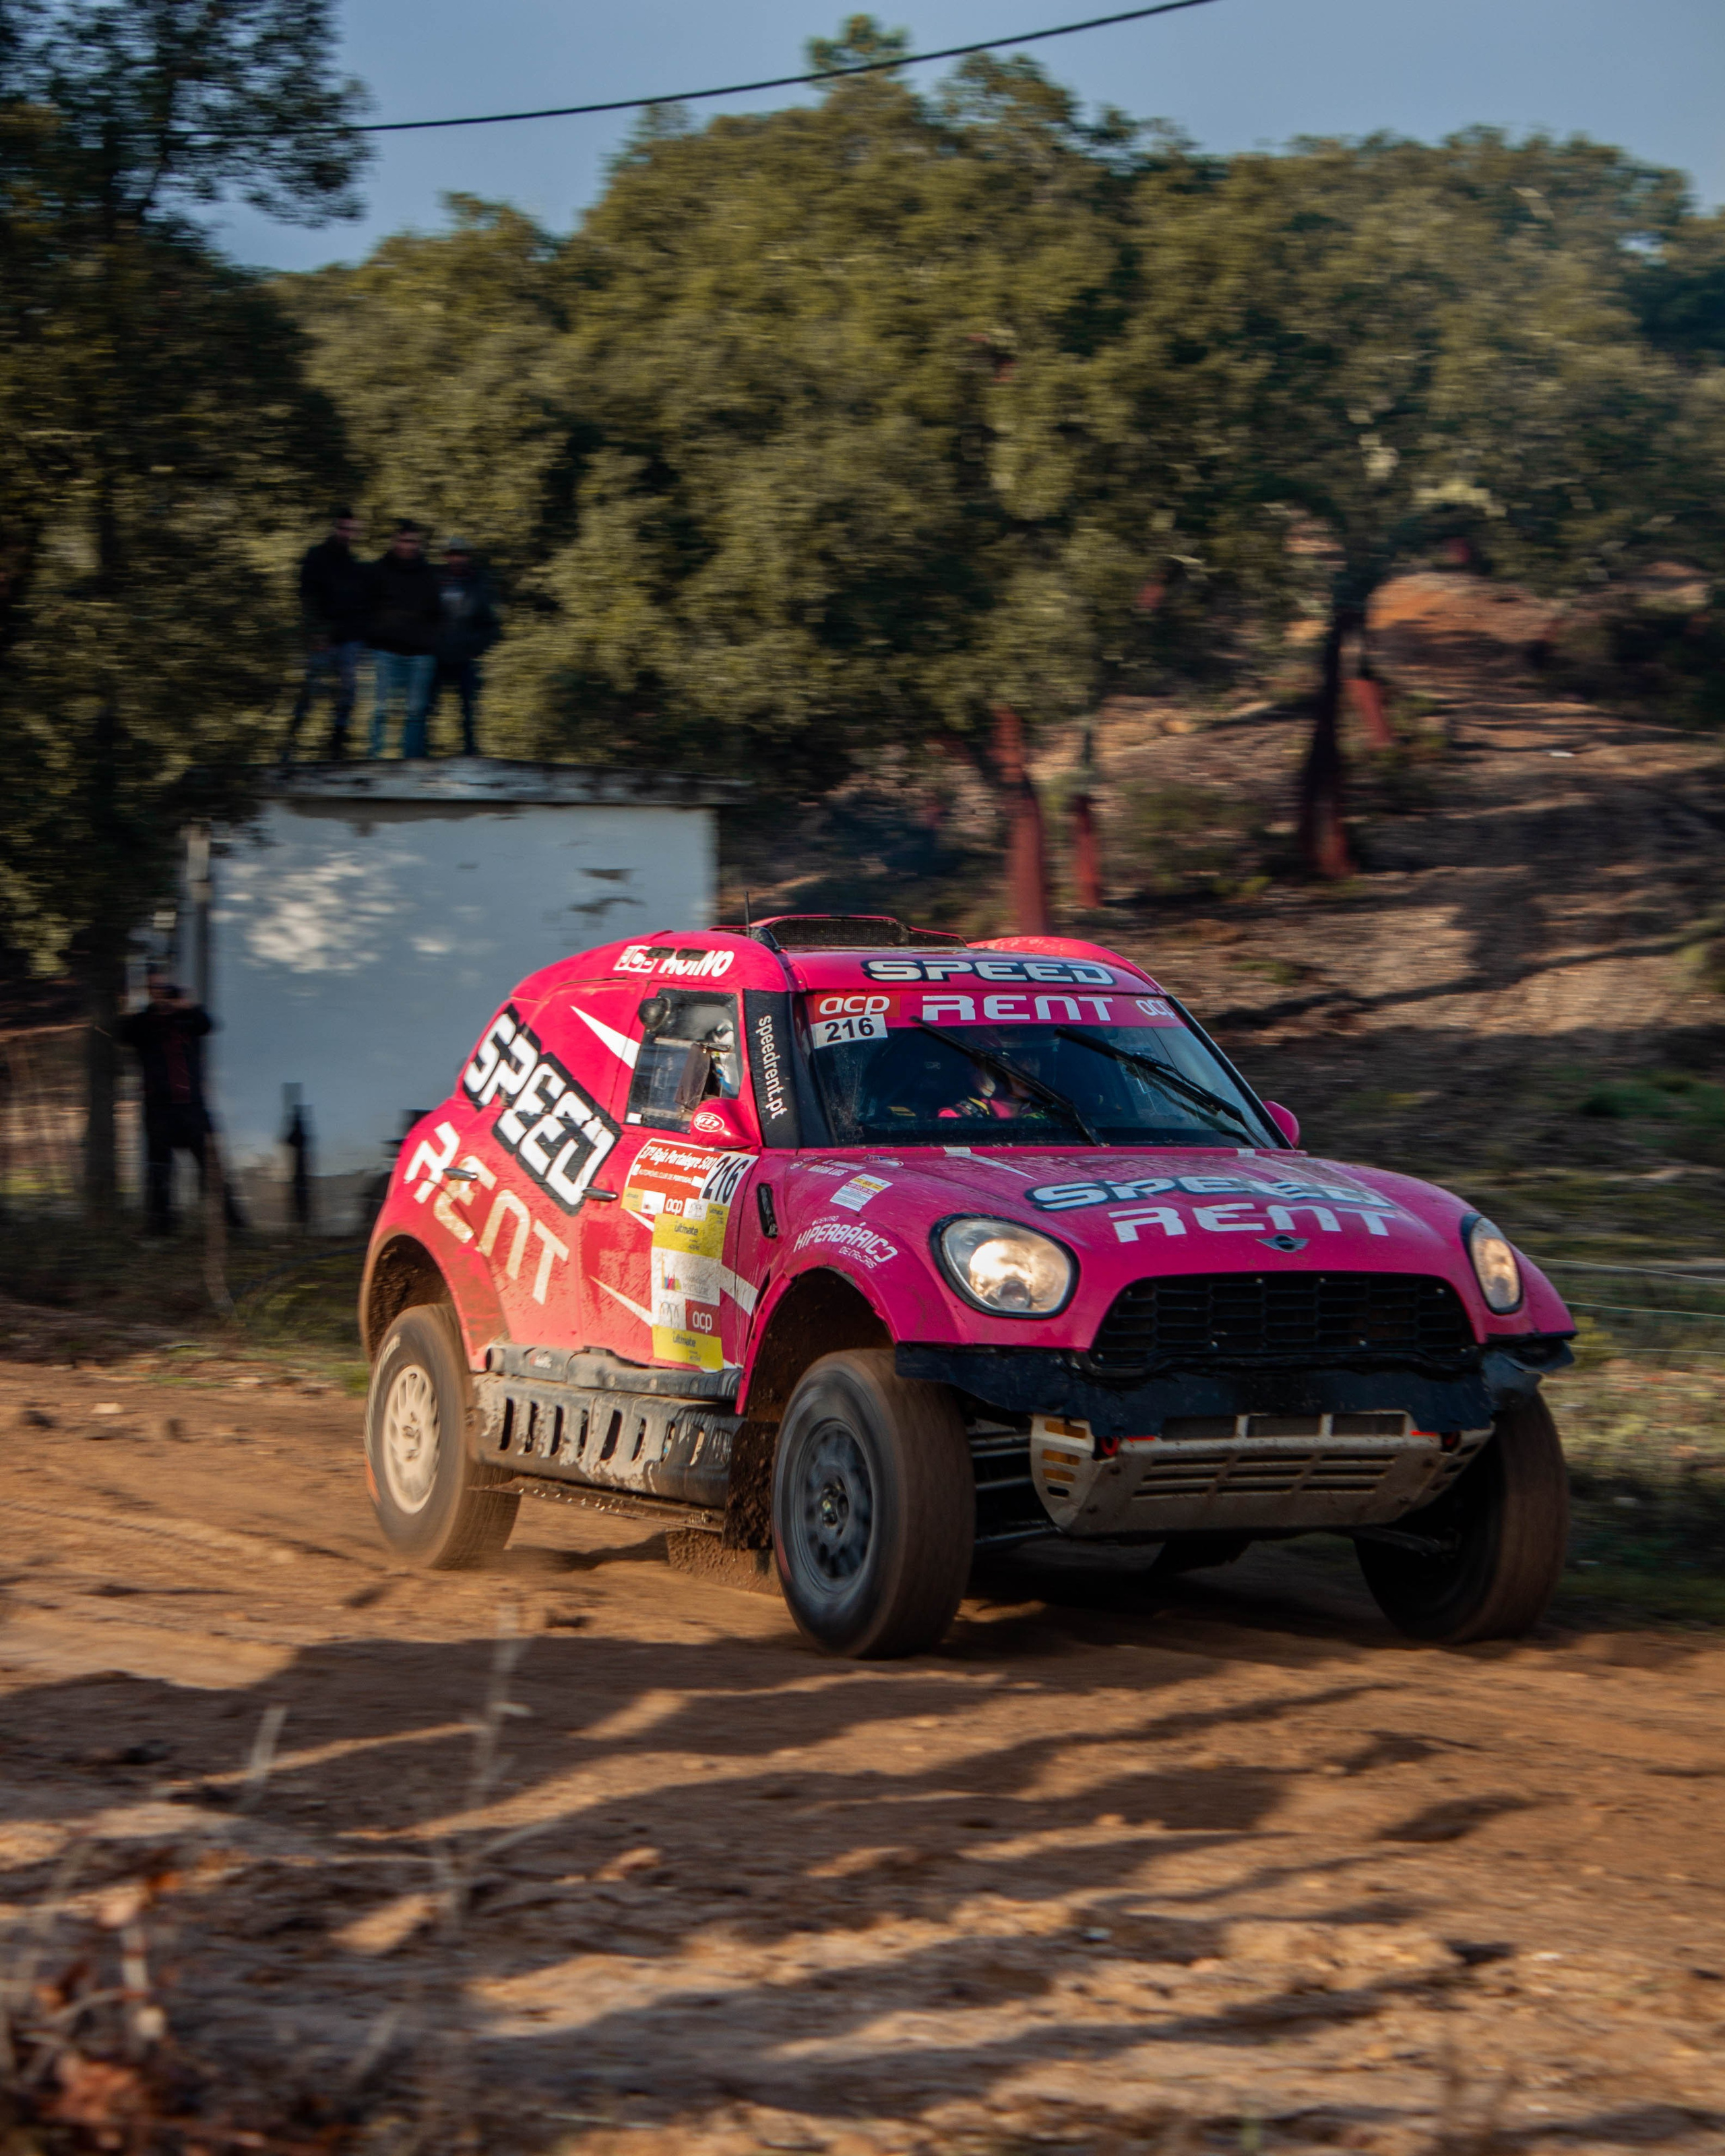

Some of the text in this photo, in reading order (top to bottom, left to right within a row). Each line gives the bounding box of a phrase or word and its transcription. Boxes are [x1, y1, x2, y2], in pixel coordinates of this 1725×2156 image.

[866, 960, 1115, 985] SPEED
[819, 996, 890, 1015] acp
[922, 995, 1113, 1021] RENT
[825, 1017, 875, 1042] 216
[755, 1015, 788, 1119] speedrent.pt
[464, 1013, 615, 1205] SPEED
[664, 1150, 702, 1171] Portalegre
[697, 1155, 718, 1170] 500
[702, 1156, 749, 1204] 216
[1034, 1176, 1395, 1210] SPEED
[404, 1121, 569, 1305] RENT
[666, 1199, 683, 1215] acp
[675, 1222, 698, 1236] ultimate
[1108, 1203, 1396, 1242] RENT
[793, 1222, 898, 1263] HIPERBÁRICO
[693, 1311, 712, 1333] acp
